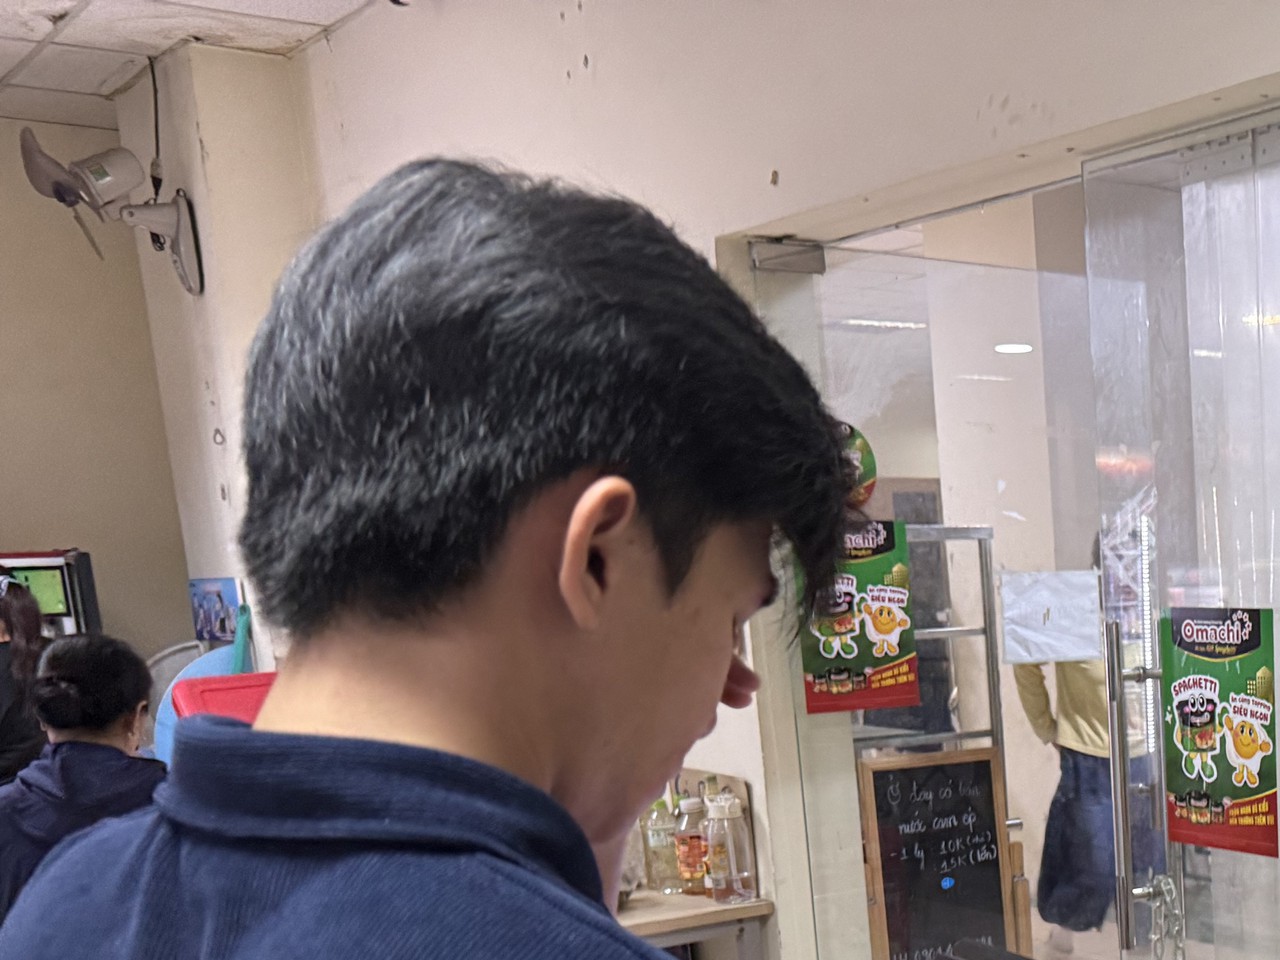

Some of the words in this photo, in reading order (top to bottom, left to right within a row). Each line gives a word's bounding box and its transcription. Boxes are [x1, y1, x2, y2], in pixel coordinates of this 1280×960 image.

[1182, 619, 1242, 644] Omachi
[1173, 677, 1217, 697] SPAGHETTI
[1233, 704, 1248, 717] SIÊU
[1250, 709, 1268, 722] NGON
